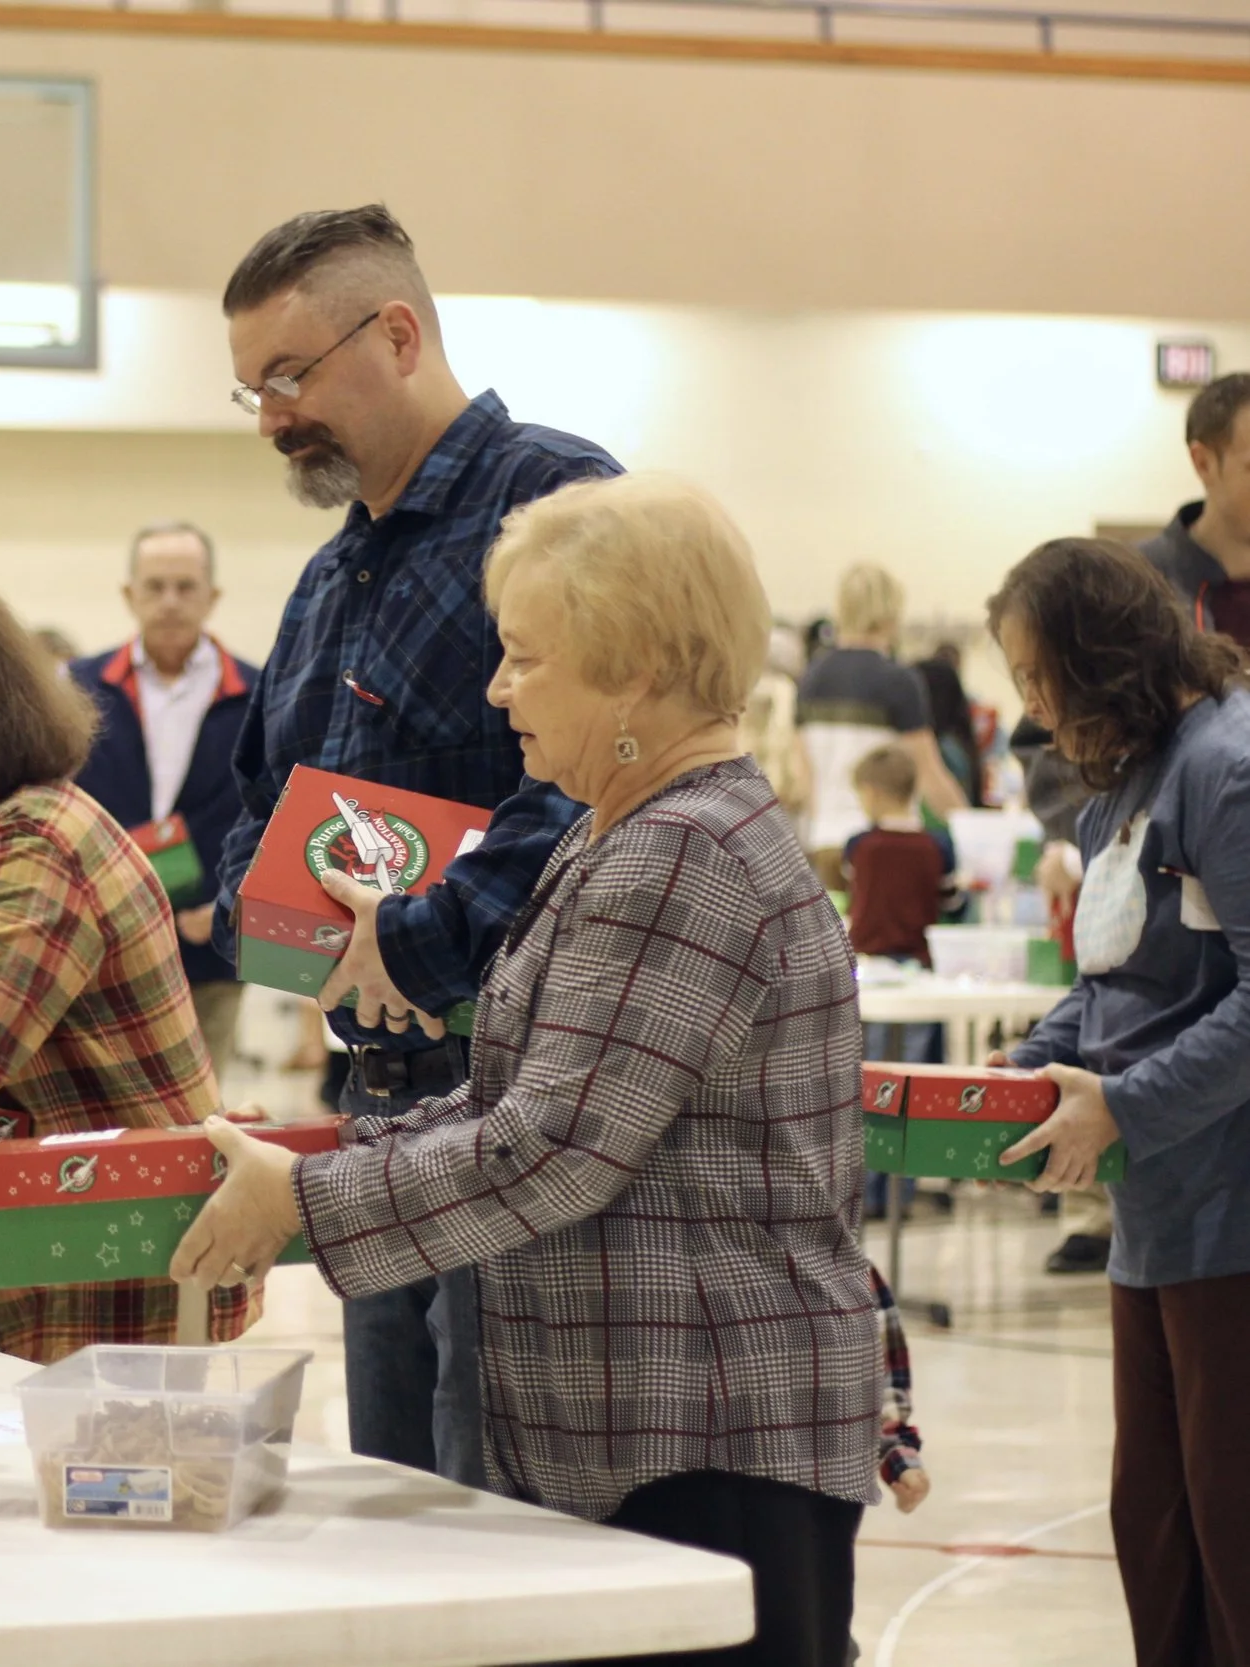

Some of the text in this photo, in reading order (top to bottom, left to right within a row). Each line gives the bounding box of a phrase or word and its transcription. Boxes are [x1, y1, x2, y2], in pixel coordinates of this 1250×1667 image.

[310, 821, 346, 847] Purse
[373, 817, 407, 867] OPERATION
[392, 821, 425, 880] Christmas Child
